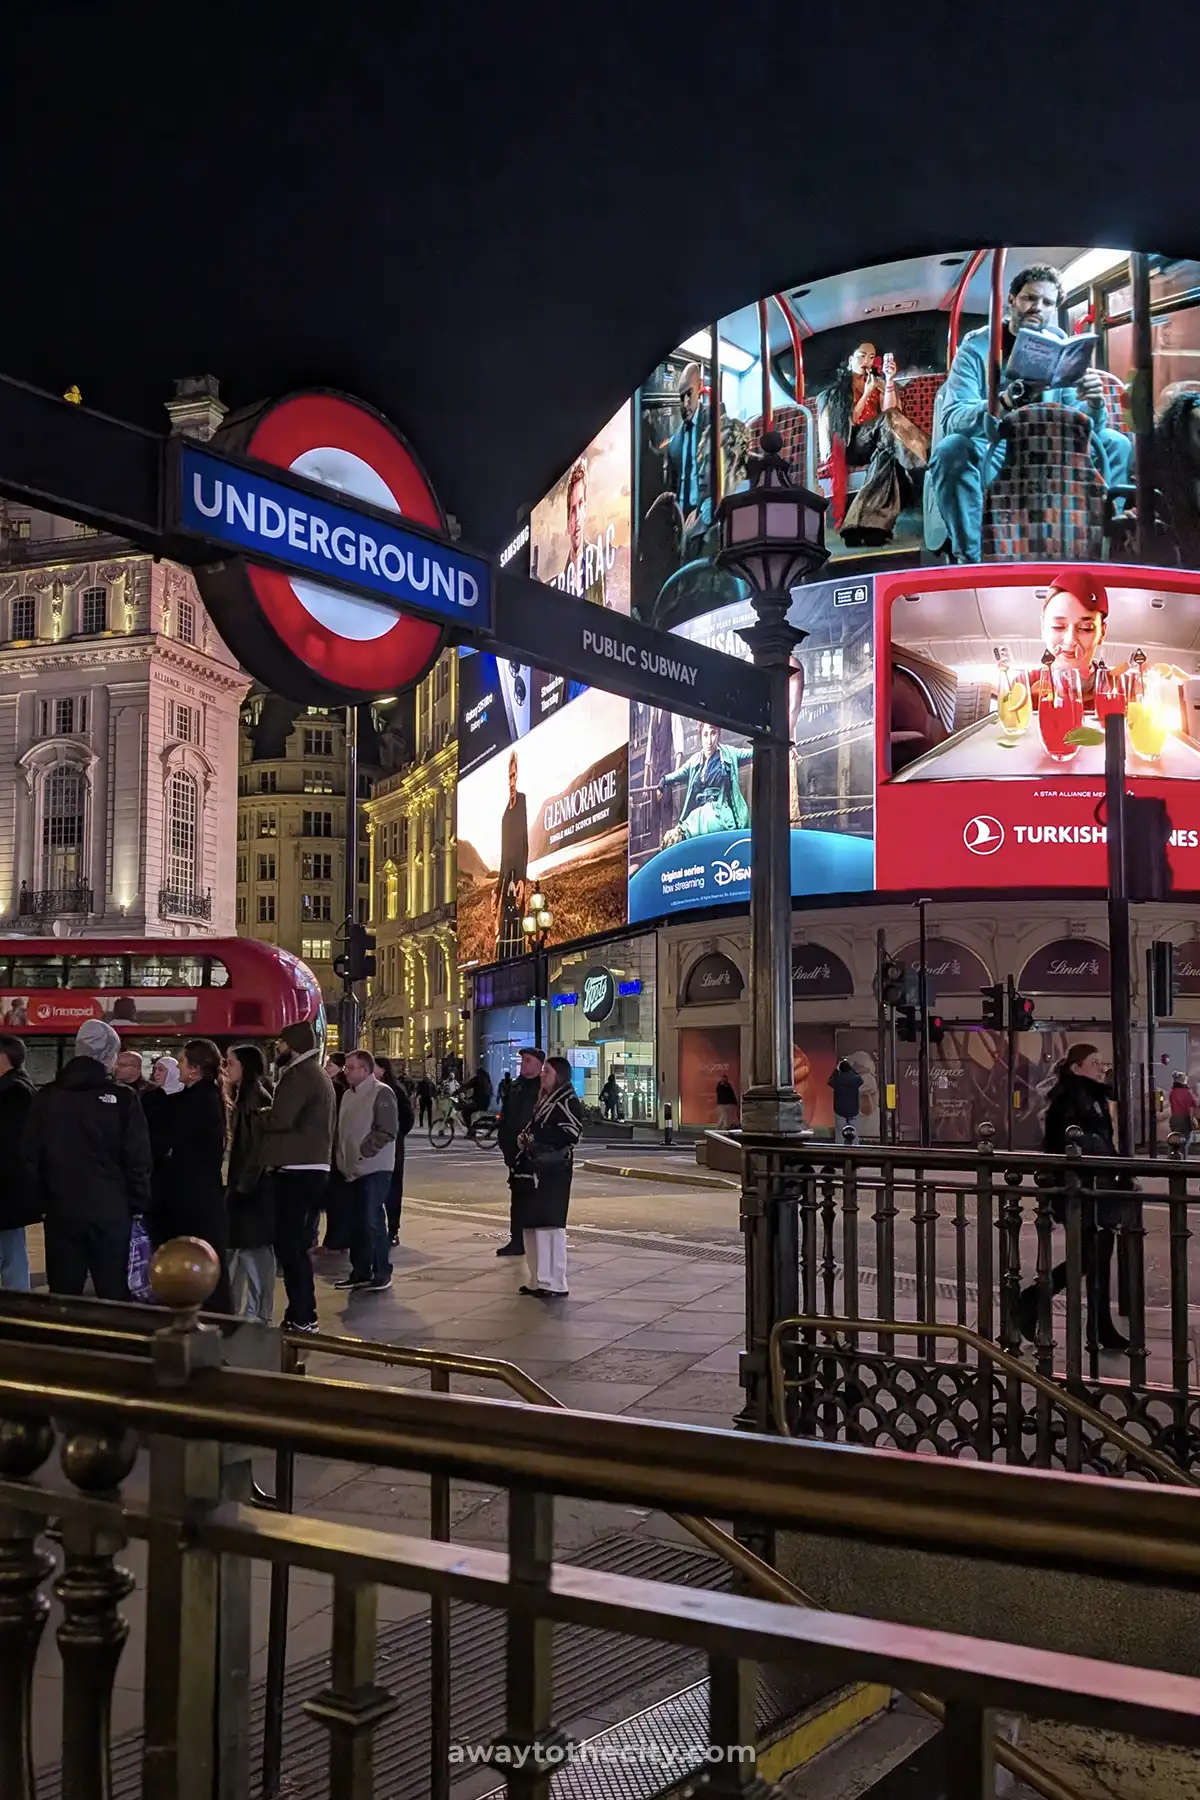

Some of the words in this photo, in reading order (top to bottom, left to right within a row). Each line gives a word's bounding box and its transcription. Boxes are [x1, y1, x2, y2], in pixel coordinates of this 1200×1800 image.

[193, 472, 479, 607] UNDERGROUND
[500, 525, 529, 568] SAMSUNG
[583, 629, 637, 666] PUBLIC
[640, 650, 698, 686] SUBWAY
[154, 671, 180, 689] ALLIANCE
[184, 684, 195, 695] LIFE
[199, 690, 216, 704] OFFICE
[544, 769, 617, 831] GLENMORANGIE
[549, 830, 564, 844] SINGLE
[564, 825, 575, 837] MALT
[575, 816, 592, 832] SCOTCH
[592, 807, 610, 823] WHISKY
[1013, 826, 1107, 843] TURKISH
[661, 867, 683, 883] Original
[683, 864, 705, 877] series
[662, 884, 674, 895] Now
[674, 877, 705, 892] streaming
[700, 972, 725, 987] Lindt
[911, 960, 950, 975] Lndt
[1046, 959, 1089, 975] Lindt
[583, 974, 607, 1013] Boots
[52, 1004, 94, 1018] Intrepid
